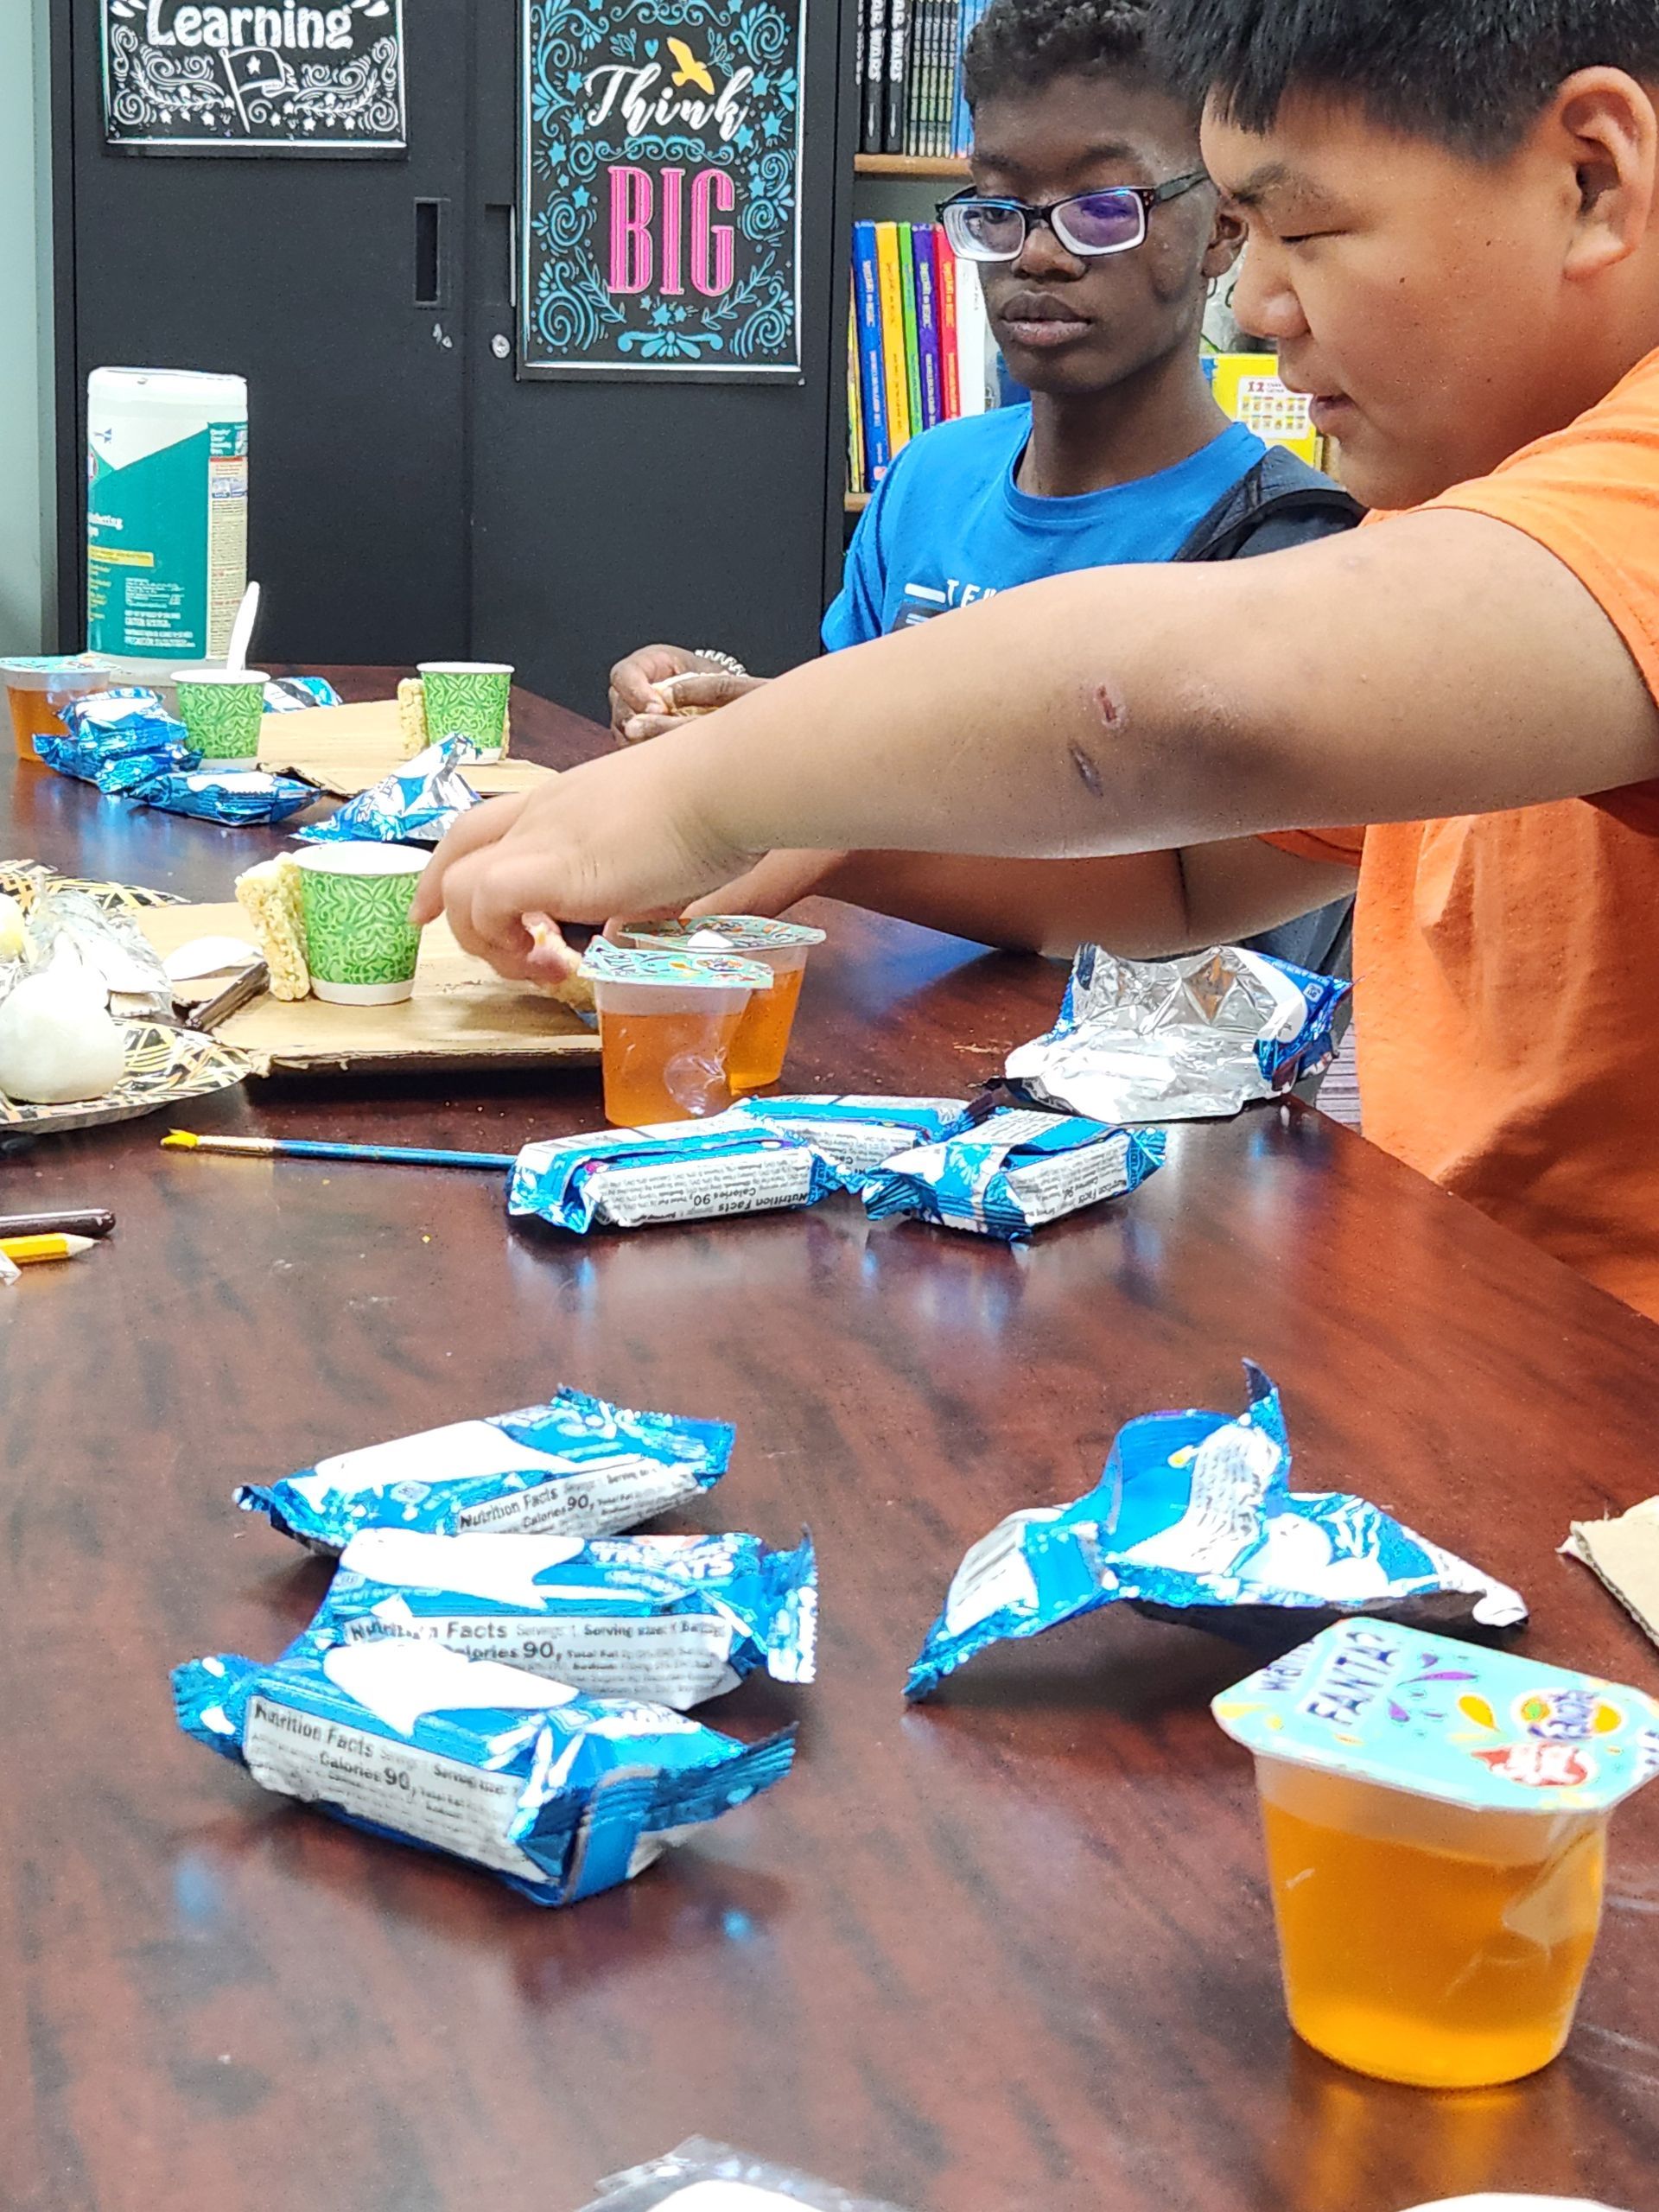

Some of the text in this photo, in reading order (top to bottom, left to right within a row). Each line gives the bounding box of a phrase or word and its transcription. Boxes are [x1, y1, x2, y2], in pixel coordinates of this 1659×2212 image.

[146, 0, 354, 50] Learning
[868, 29, 887, 83] WARS
[889, 29, 905, 83] WARS
[582, 62, 755, 142] Think
[606, 165, 736, 297] BIG
[717, 1193, 808, 1212] Nutrition Facts
[460, 1500, 521, 1529] Nutrition
[524, 1486, 559, 1510] Facts
[446, 1621, 508, 1640] Facts
[254, 1703, 321, 1741] Nutrition
[327, 1724, 375, 1758] Facts
